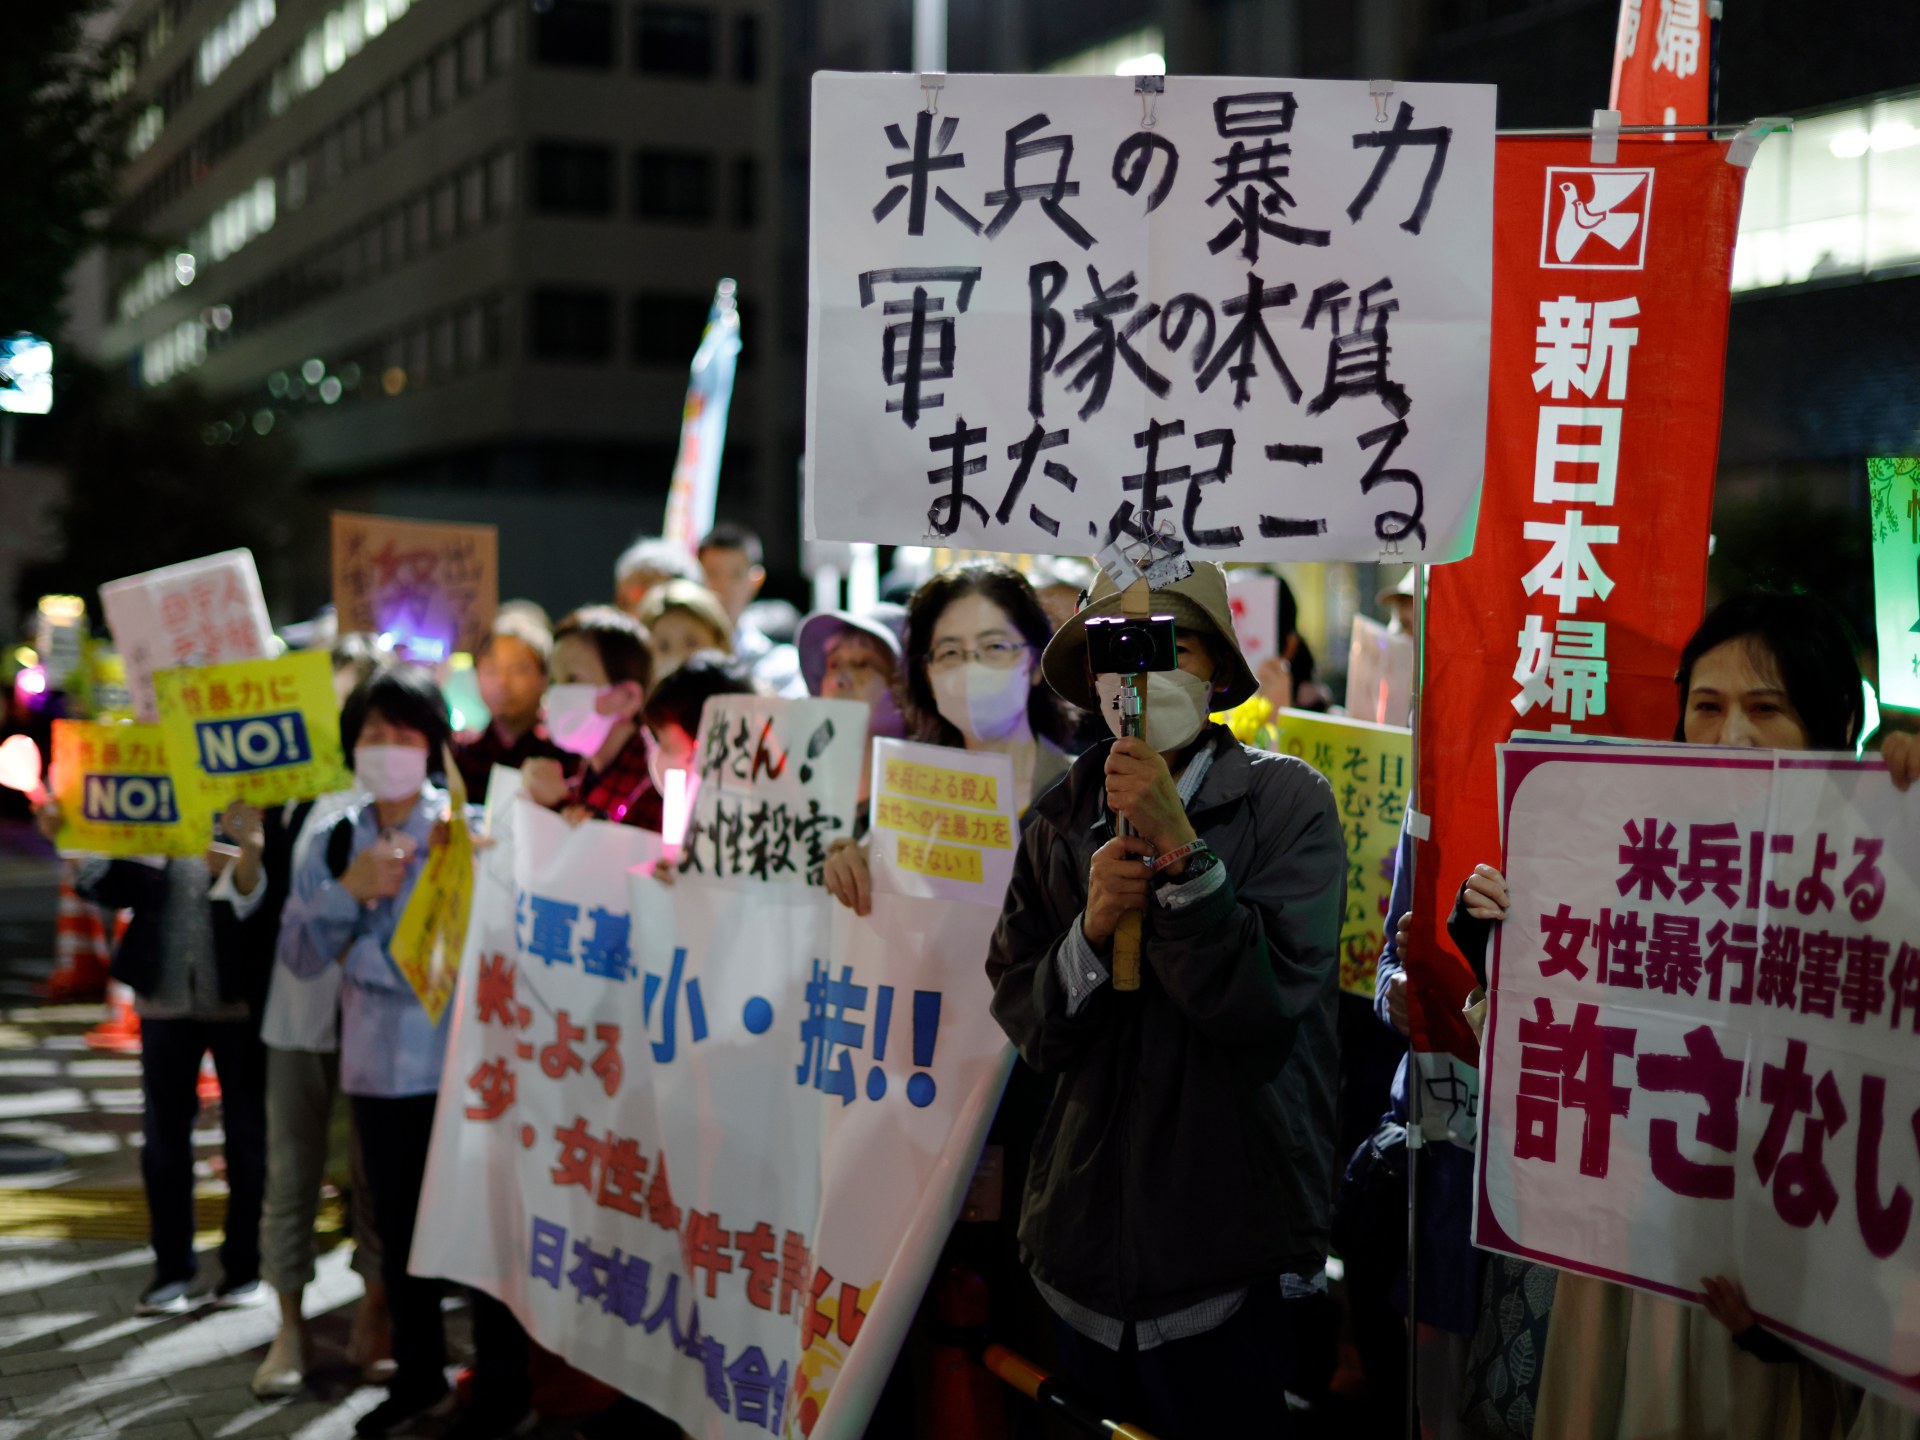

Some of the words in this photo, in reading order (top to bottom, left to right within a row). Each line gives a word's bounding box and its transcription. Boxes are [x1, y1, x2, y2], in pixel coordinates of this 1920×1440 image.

[872, 91, 1453, 265] 米兵の暴力
[858, 260, 1413, 429] 軍隊の本質
[1510, 295, 1642, 734] 新日本婦
[87, 777, 171, 820] NO!
[202, 715, 300, 770] NO!
[885, 764, 997, 805] 米兵による殺人
[877, 802, 1009, 845] 女性への性暴力を
[1615, 817, 1886, 922] 米兵による
[1538, 903, 1920, 1035] 女性暴行殺害事件
[1513, 996, 1920, 1259] 許さない
